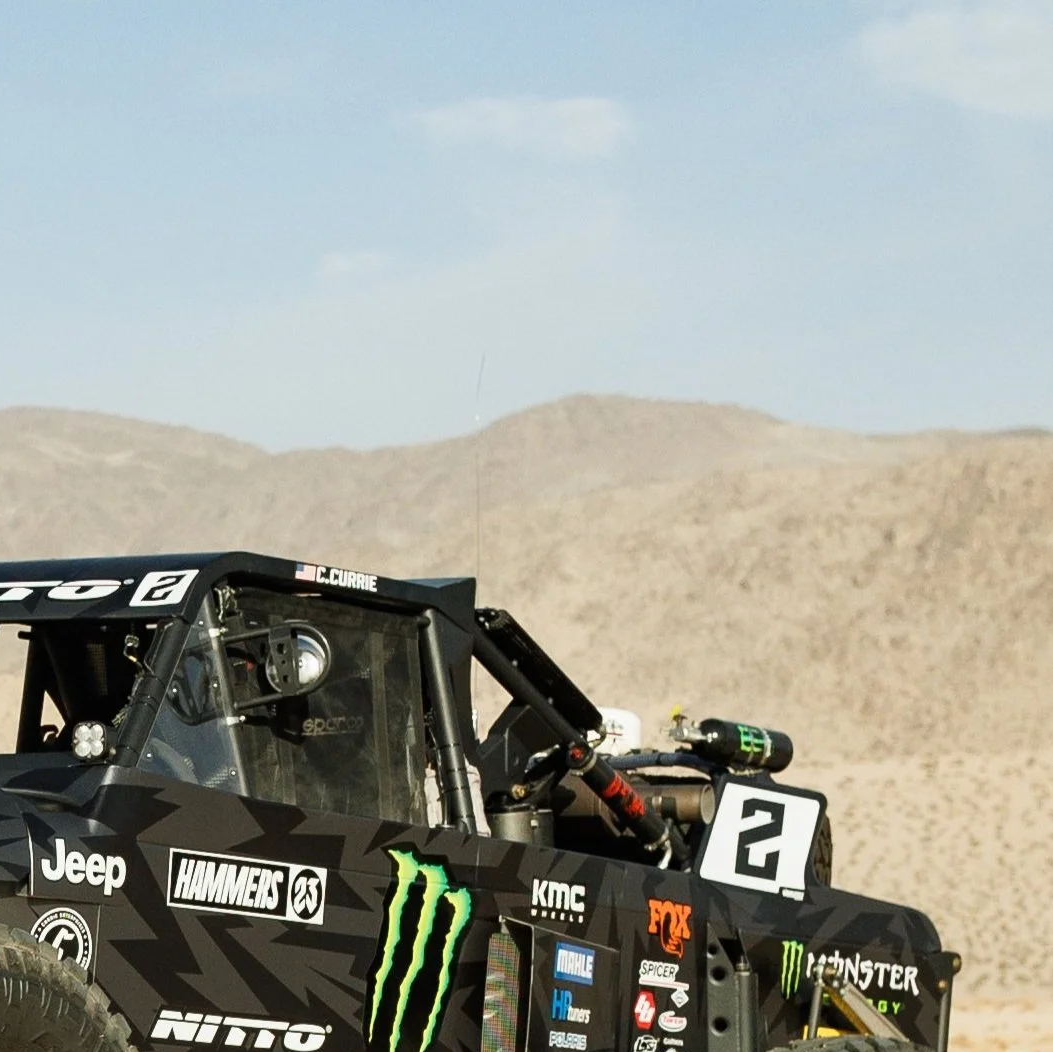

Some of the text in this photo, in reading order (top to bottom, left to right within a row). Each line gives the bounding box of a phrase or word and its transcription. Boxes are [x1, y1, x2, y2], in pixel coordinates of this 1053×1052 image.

[316, 566, 378, 592] C.CURRIE
[734, 797, 786, 882] 2
[41, 838, 127, 896] Jeep
[173, 857, 320, 915] HAMMERS 23
[648, 899, 692, 958] FOX
[556, 948, 594, 980] MAHLE
[640, 961, 678, 979] SPICER
[551, 988, 591, 1025] HP tuners
[150, 1009, 327, 1052] NITTO
[549, 1030, 588, 1051] POLARIS
